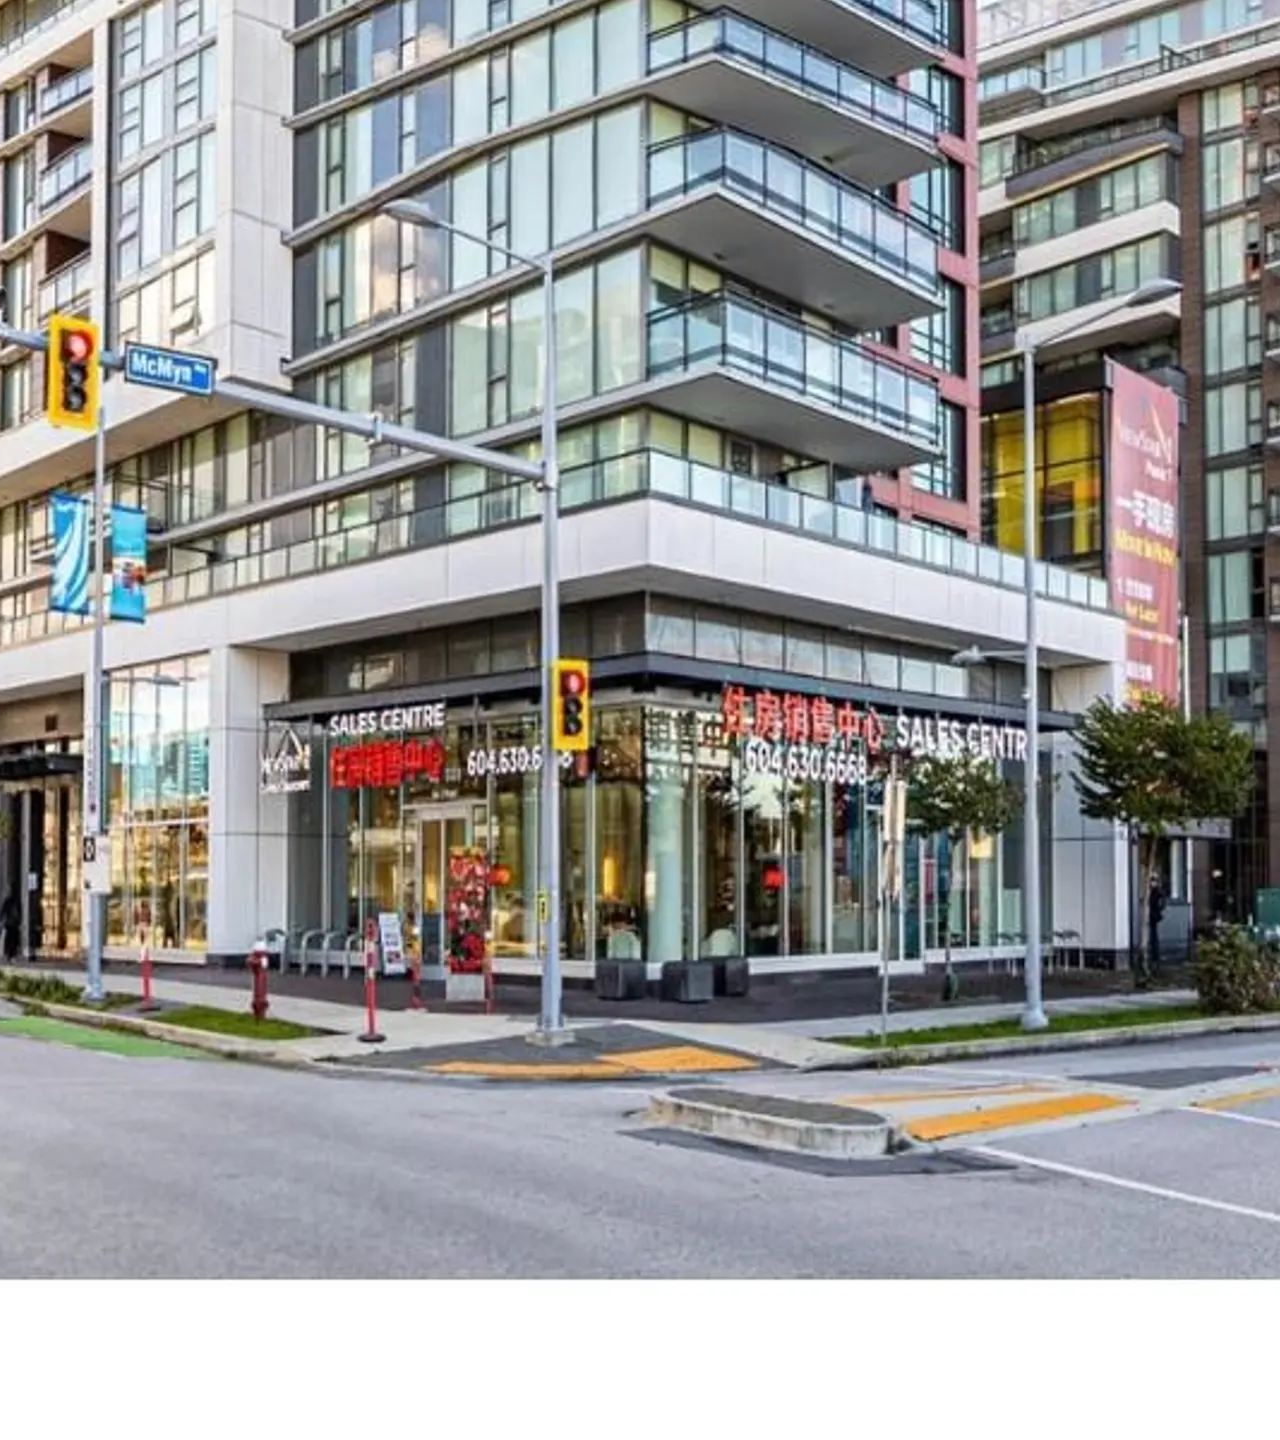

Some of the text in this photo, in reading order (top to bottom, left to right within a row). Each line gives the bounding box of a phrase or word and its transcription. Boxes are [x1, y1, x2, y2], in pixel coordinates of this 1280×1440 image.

[131, 351, 193, 385] McMyn
[330, 703, 447, 736] SALES CENTRE
[896, 714, 1029, 761] SALES CENTR
[466, 744, 574, 776] 604.630.68
[745, 735, 868, 786] 604.630.6668
